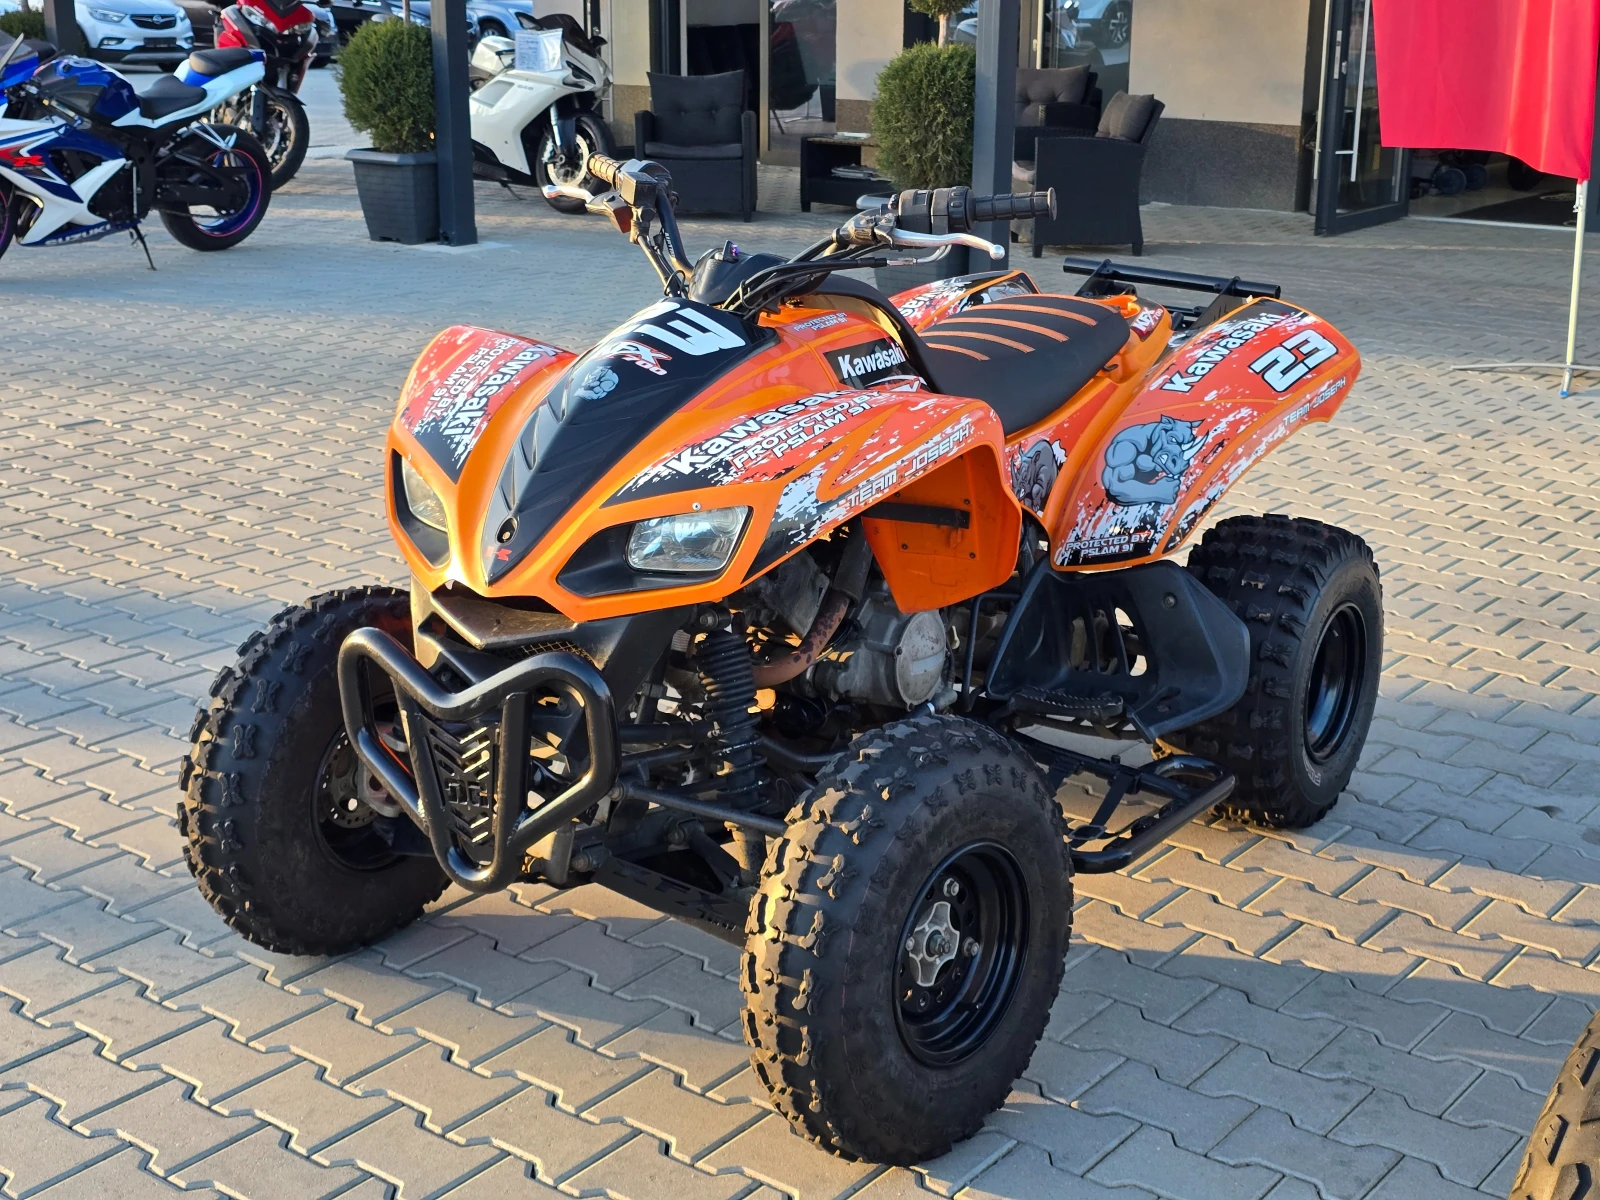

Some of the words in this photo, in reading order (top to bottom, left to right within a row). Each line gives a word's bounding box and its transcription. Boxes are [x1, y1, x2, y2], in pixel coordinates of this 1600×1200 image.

[793, 314, 837, 332] PROTECTED
[1152, 308, 1164, 320] 700
[450, 337, 520, 398] PROTECTED
[621, 356, 668, 376] 700
[837, 343, 906, 379] Kawasaki
[1161, 312, 1287, 393] Kawasaki
[1249, 329, 1338, 393] 23
[432, 394, 453, 418] BY
[443, 344, 563, 437] Kawasaki
[1283, 402, 1311, 425] TEAM
[1312, 376, 1347, 410] JOSEPH
[666, 389, 862, 476] Kawasak
[733, 402, 851, 470] PROTECTED
[852, 390, 880, 404] BY
[772, 411, 848, 460] PSLAM
[847, 402, 873, 417] 91
[848, 470, 898, 508] TEAM
[904, 422, 971, 478] JOSEPH
[1066, 535, 1129, 551] PROTECTED
[1130, 533, 1148, 543] BY
[1080, 544, 1120, 557] PSLAM
[1121, 543, 1134, 552] 91
